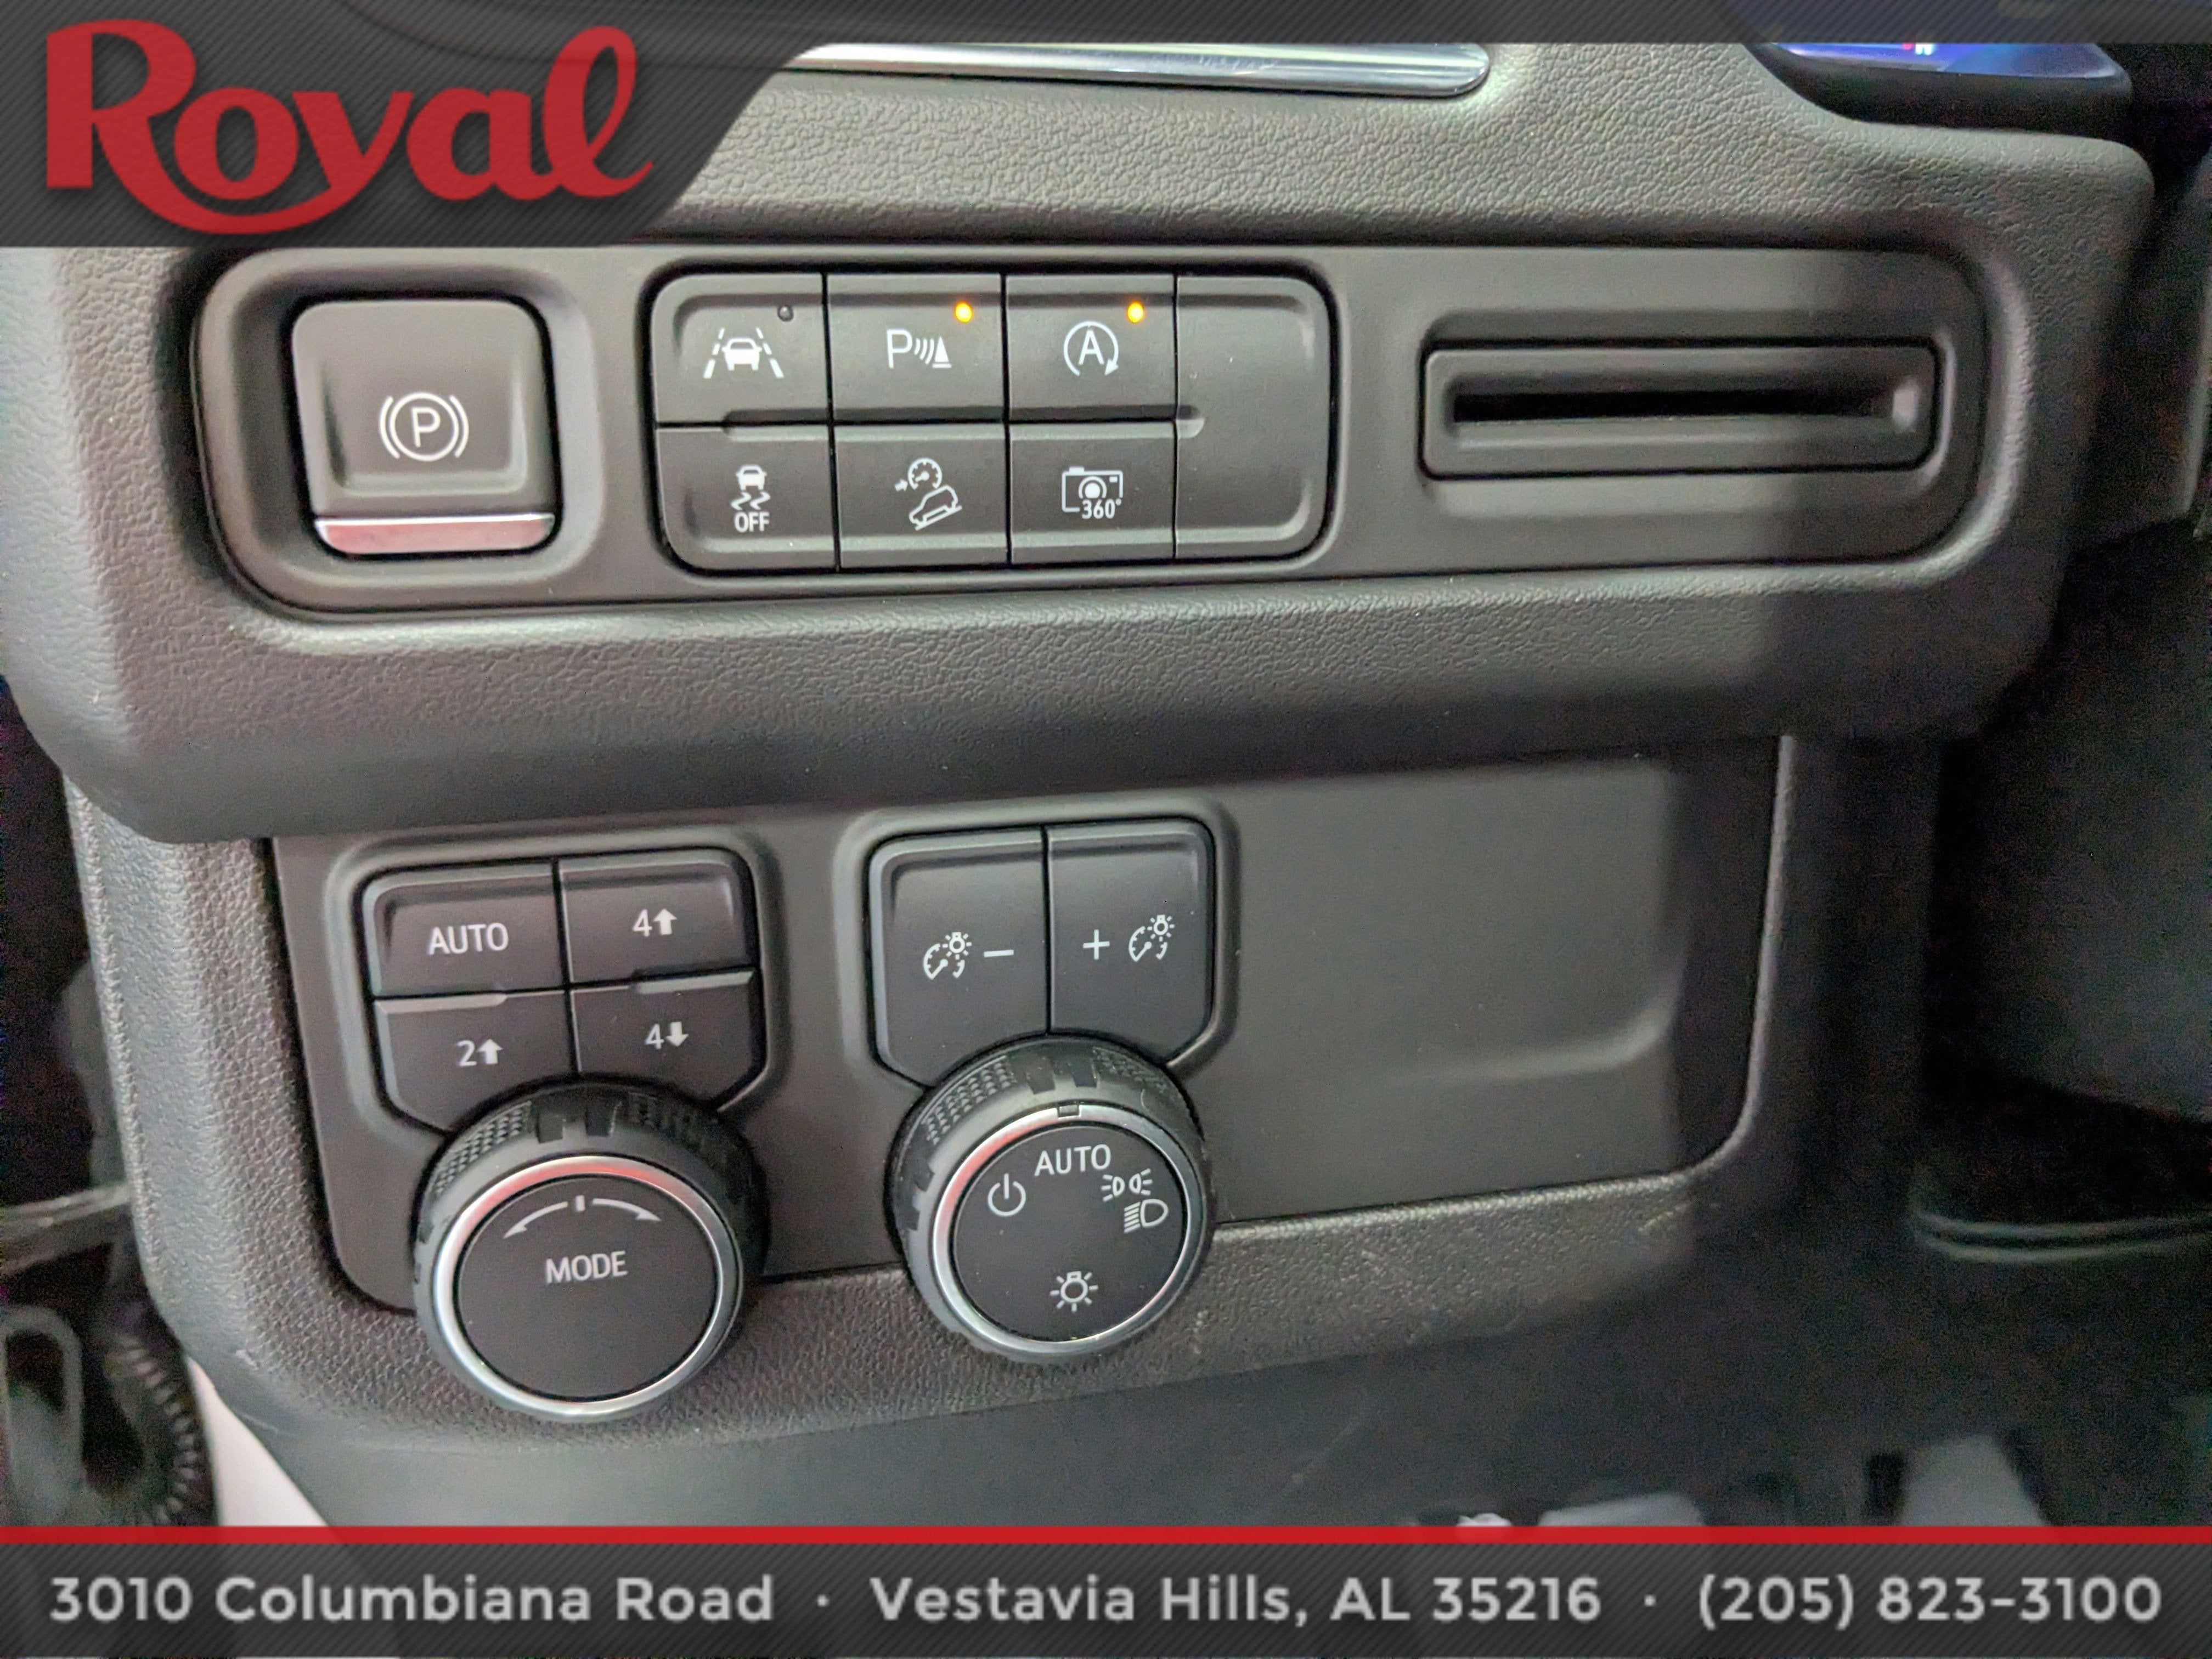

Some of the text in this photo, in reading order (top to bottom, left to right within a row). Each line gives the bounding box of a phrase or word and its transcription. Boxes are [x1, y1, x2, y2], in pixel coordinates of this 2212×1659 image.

[886, 328, 913, 369] P
[1079, 329, 1104, 365] A
[411, 407, 441, 448] P
[734, 511, 770, 533] OFF
[428, 922, 509, 955] AUTO
[1034, 1143, 1112, 1177] AUTO
[545, 1250, 628, 1284] MODE
